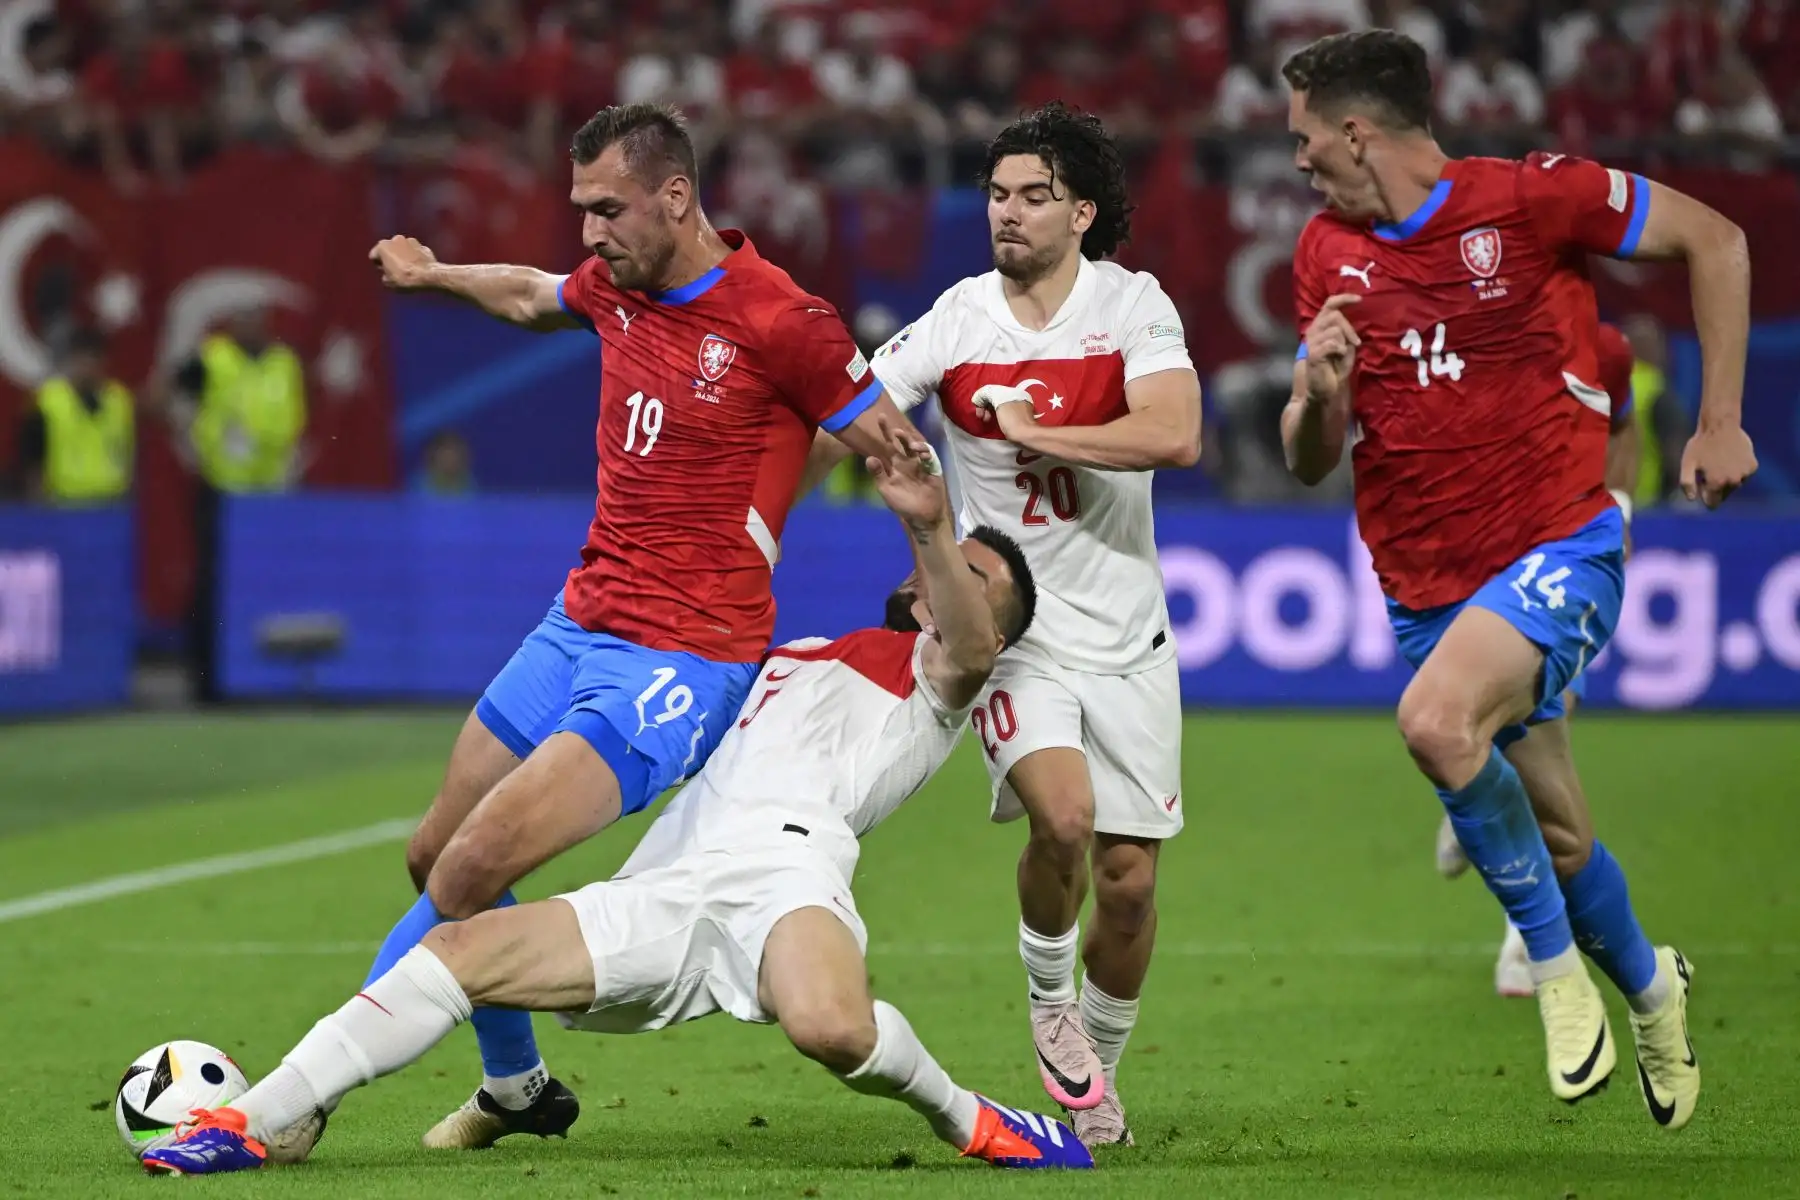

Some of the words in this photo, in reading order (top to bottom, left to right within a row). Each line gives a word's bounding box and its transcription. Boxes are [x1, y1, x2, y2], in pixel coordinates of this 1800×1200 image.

[1400, 322, 1465, 387] 14
[624, 391, 664, 457] 19
[1015, 466, 1081, 527] 20
[1518, 552, 1573, 609] 14
[637, 667, 694, 725] 19
[971, 689, 1020, 763] 20
